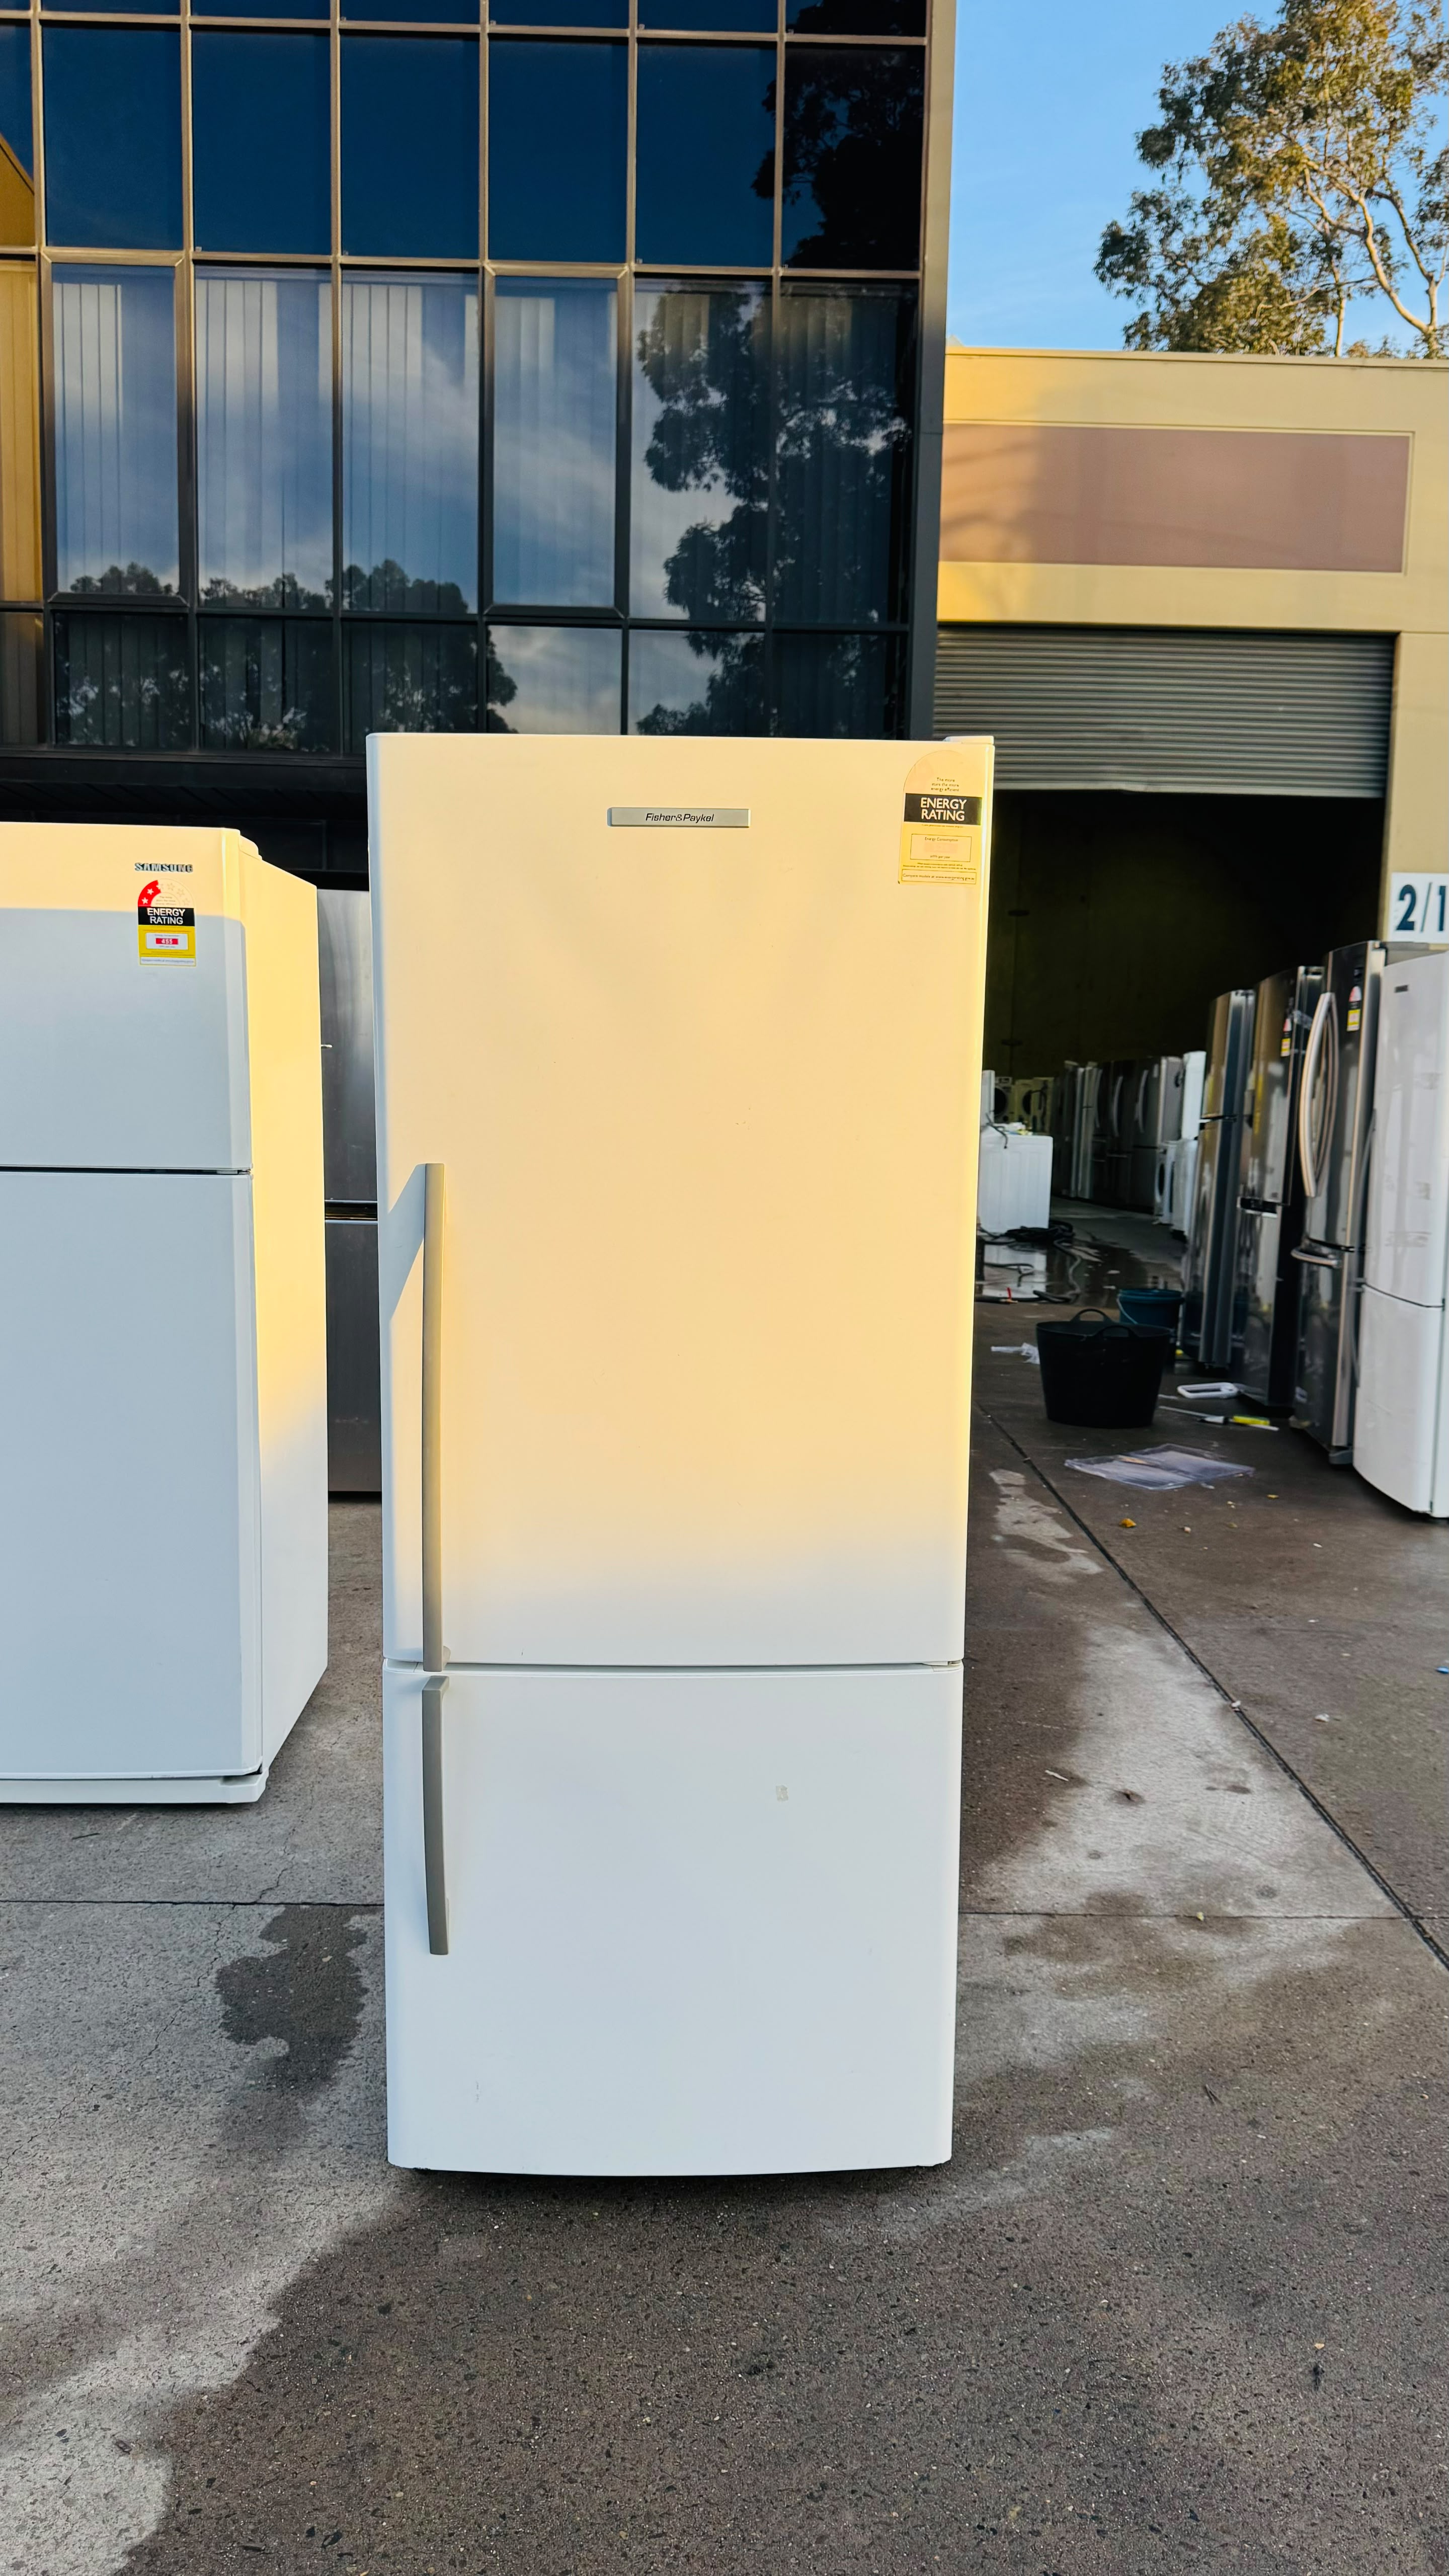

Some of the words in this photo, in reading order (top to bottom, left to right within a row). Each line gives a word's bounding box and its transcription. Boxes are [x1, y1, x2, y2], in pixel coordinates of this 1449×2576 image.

[920, 797, 967, 810] ENERGY
[921, 809, 965, 821] RATING
[134, 862, 193, 873] SAMSUNG
[147, 908, 185, 916] ENERGY
[149, 916, 183, 925] RATING
